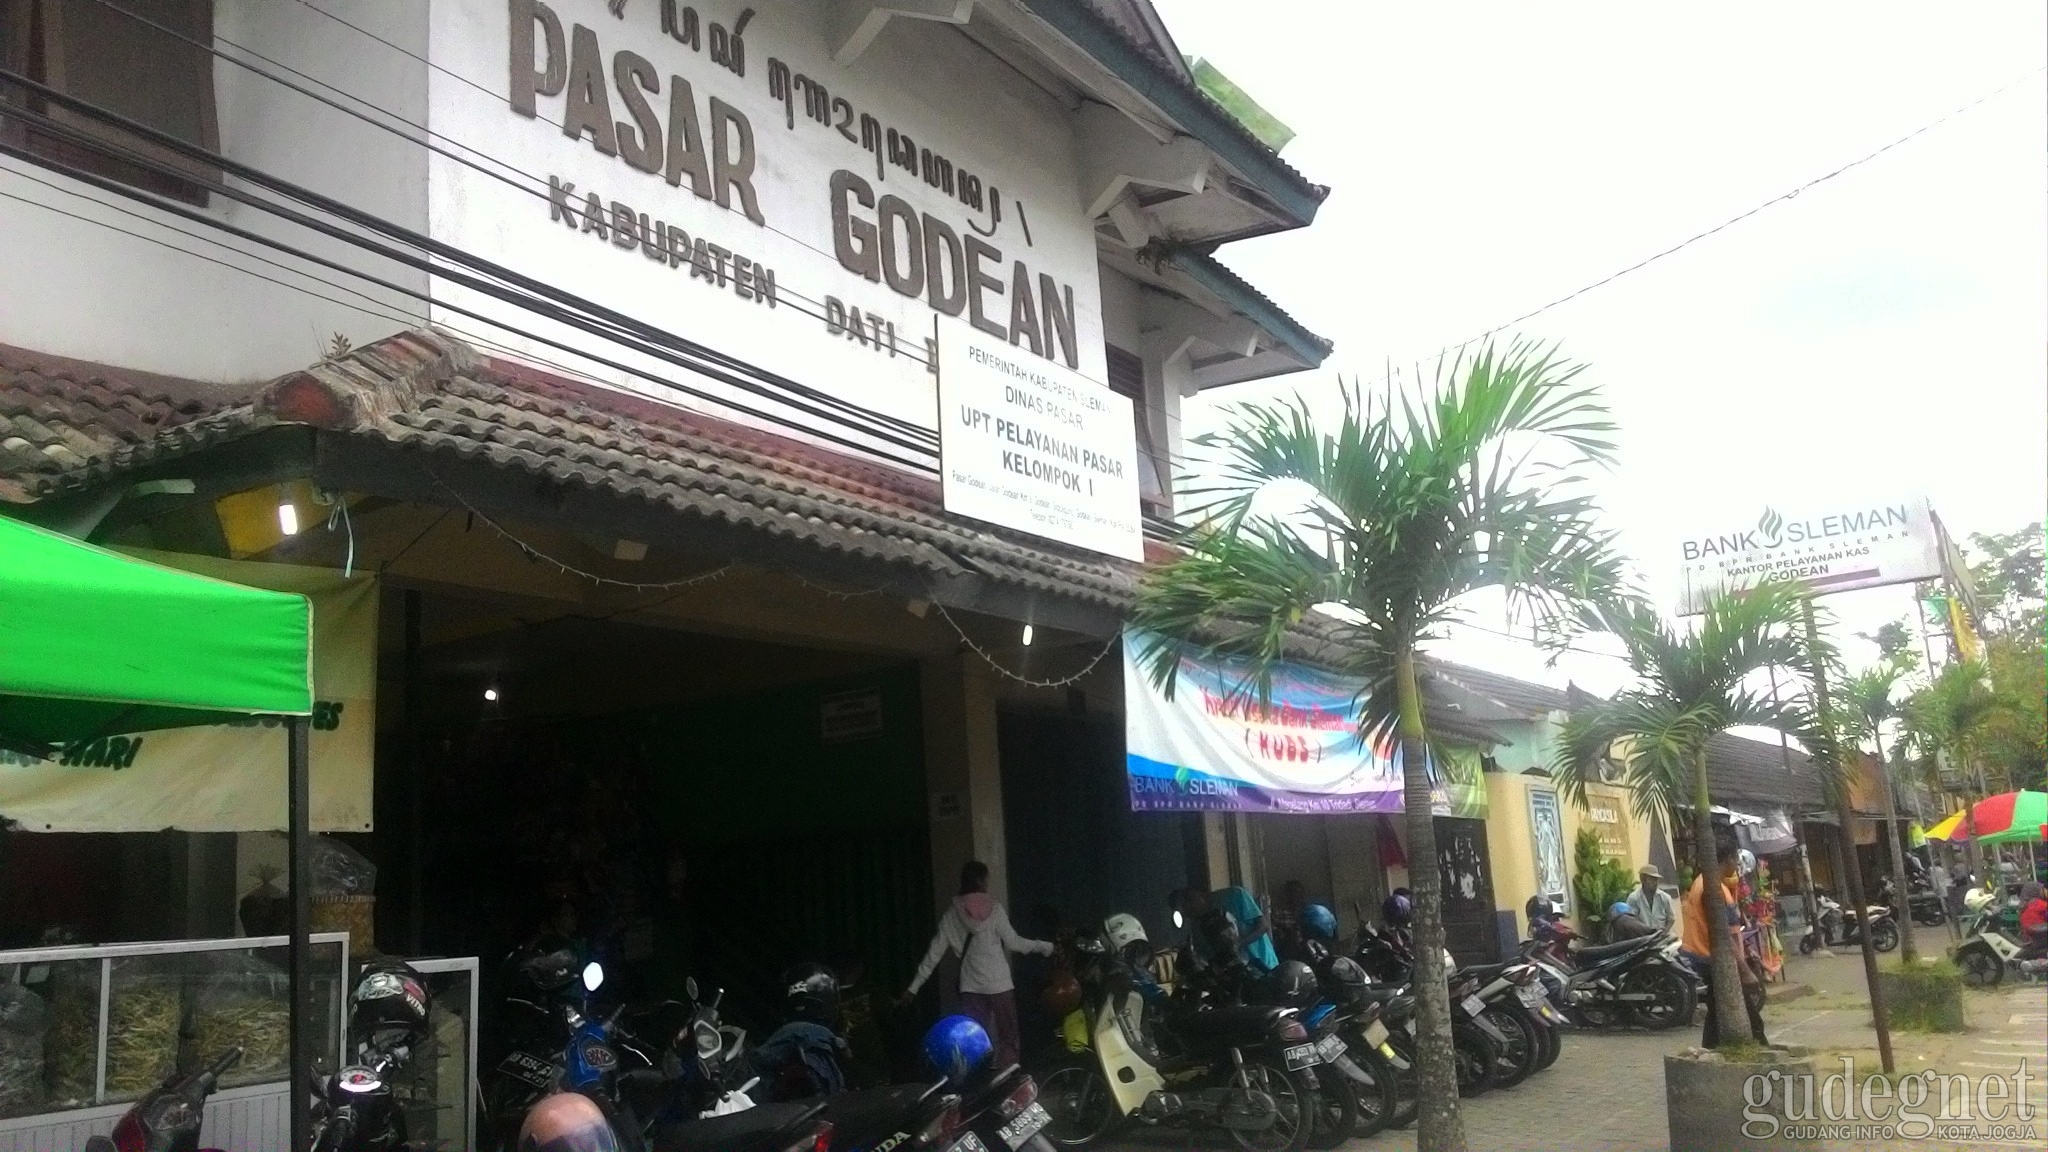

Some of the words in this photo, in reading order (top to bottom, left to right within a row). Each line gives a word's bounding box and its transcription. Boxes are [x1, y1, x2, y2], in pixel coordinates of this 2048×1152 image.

[508, 0, 765, 226] PASAR
[829, 169, 1079, 369] GODEAN
[549, 175, 776, 309] KABUPATEN
[825, 294, 895, 358] DATI
[968, 345, 1028, 382] PEMERINTAH
[1005, 385, 1044, 415] DINAS
[1046, 401, 1084, 431] PASAR
[961, 404, 991, 433] UPT
[996, 417, 1079, 465] PELAYANAN
[1083, 448, 1123, 480] PASAR
[1002, 449, 1081, 494] KELOMPOK
[1088, 478, 1093, 497] I
[1683, 529, 1760, 561] BANK
[1787, 504, 1908, 543] SLEMAN
[1829, 530, 1909, 550] SLEMAN
[1727, 563, 1773, 577] KANTOR
[1776, 552, 1843, 569] PELAYANAN
[1845, 546, 1870, 558] KAS
[1769, 563, 1829, 582] GODEAN
[1135, 777, 1174, 794] BANK
[1189, 778, 1239, 797] SLEMAN
[998, 1126, 1013, 1141] AB
[1010, 1111, 1032, 1131] 5869
